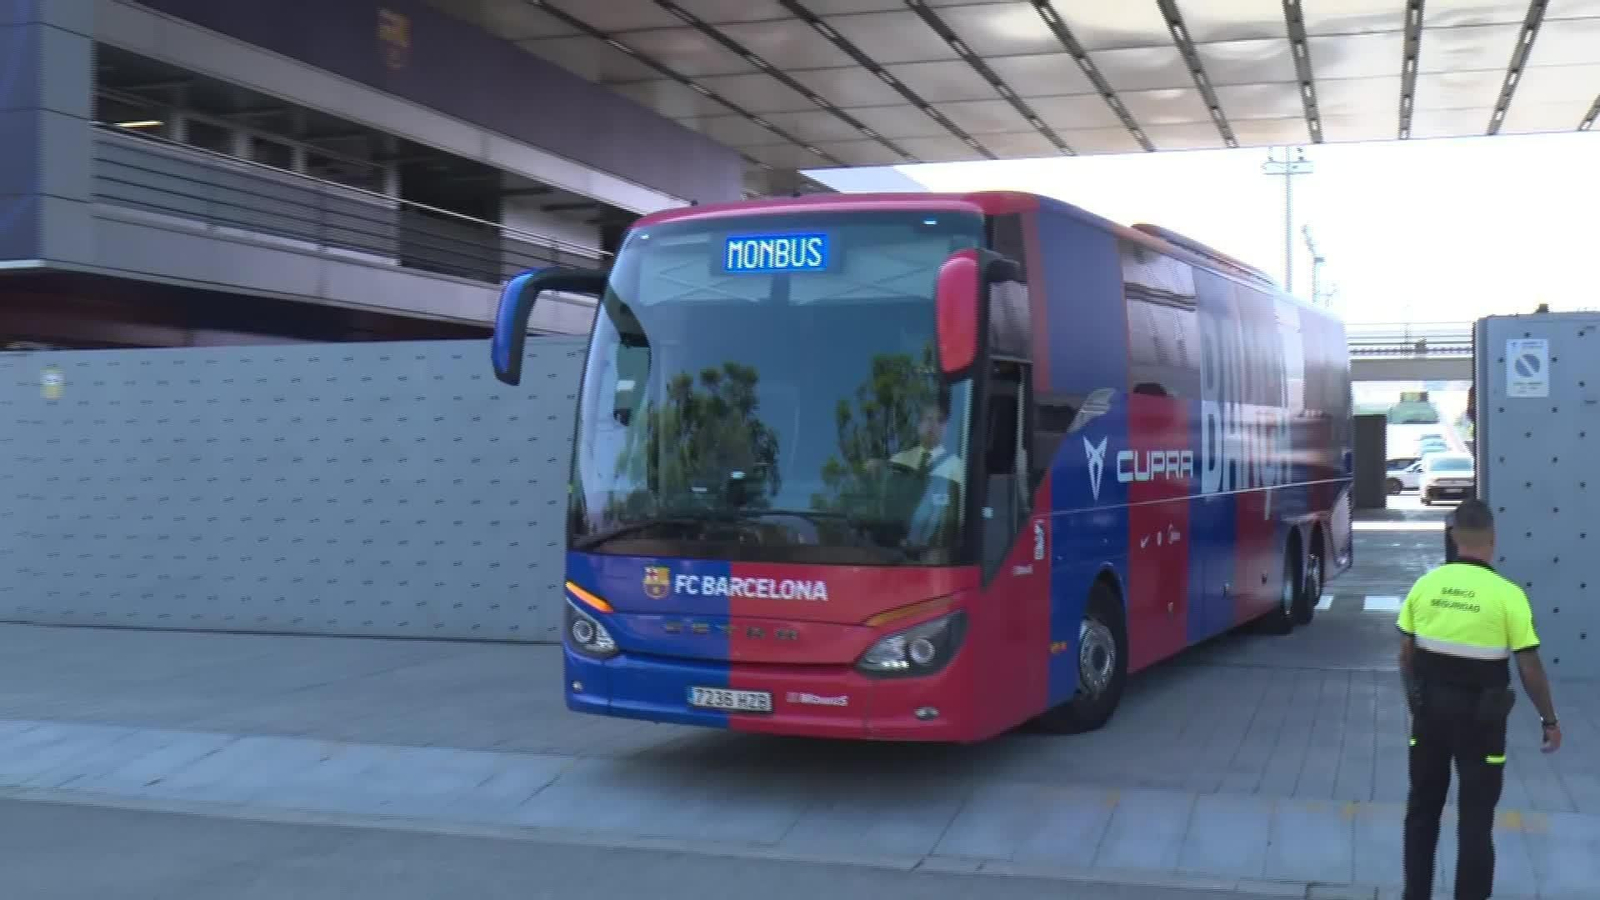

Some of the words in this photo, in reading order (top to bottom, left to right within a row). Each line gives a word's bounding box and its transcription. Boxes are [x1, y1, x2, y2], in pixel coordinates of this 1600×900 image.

[727, 237, 823, 269] MONBUS
[1117, 450, 1194, 483] CUPRA
[674, 574, 699, 595] FC
[702, 576, 829, 601] BARCELONA
